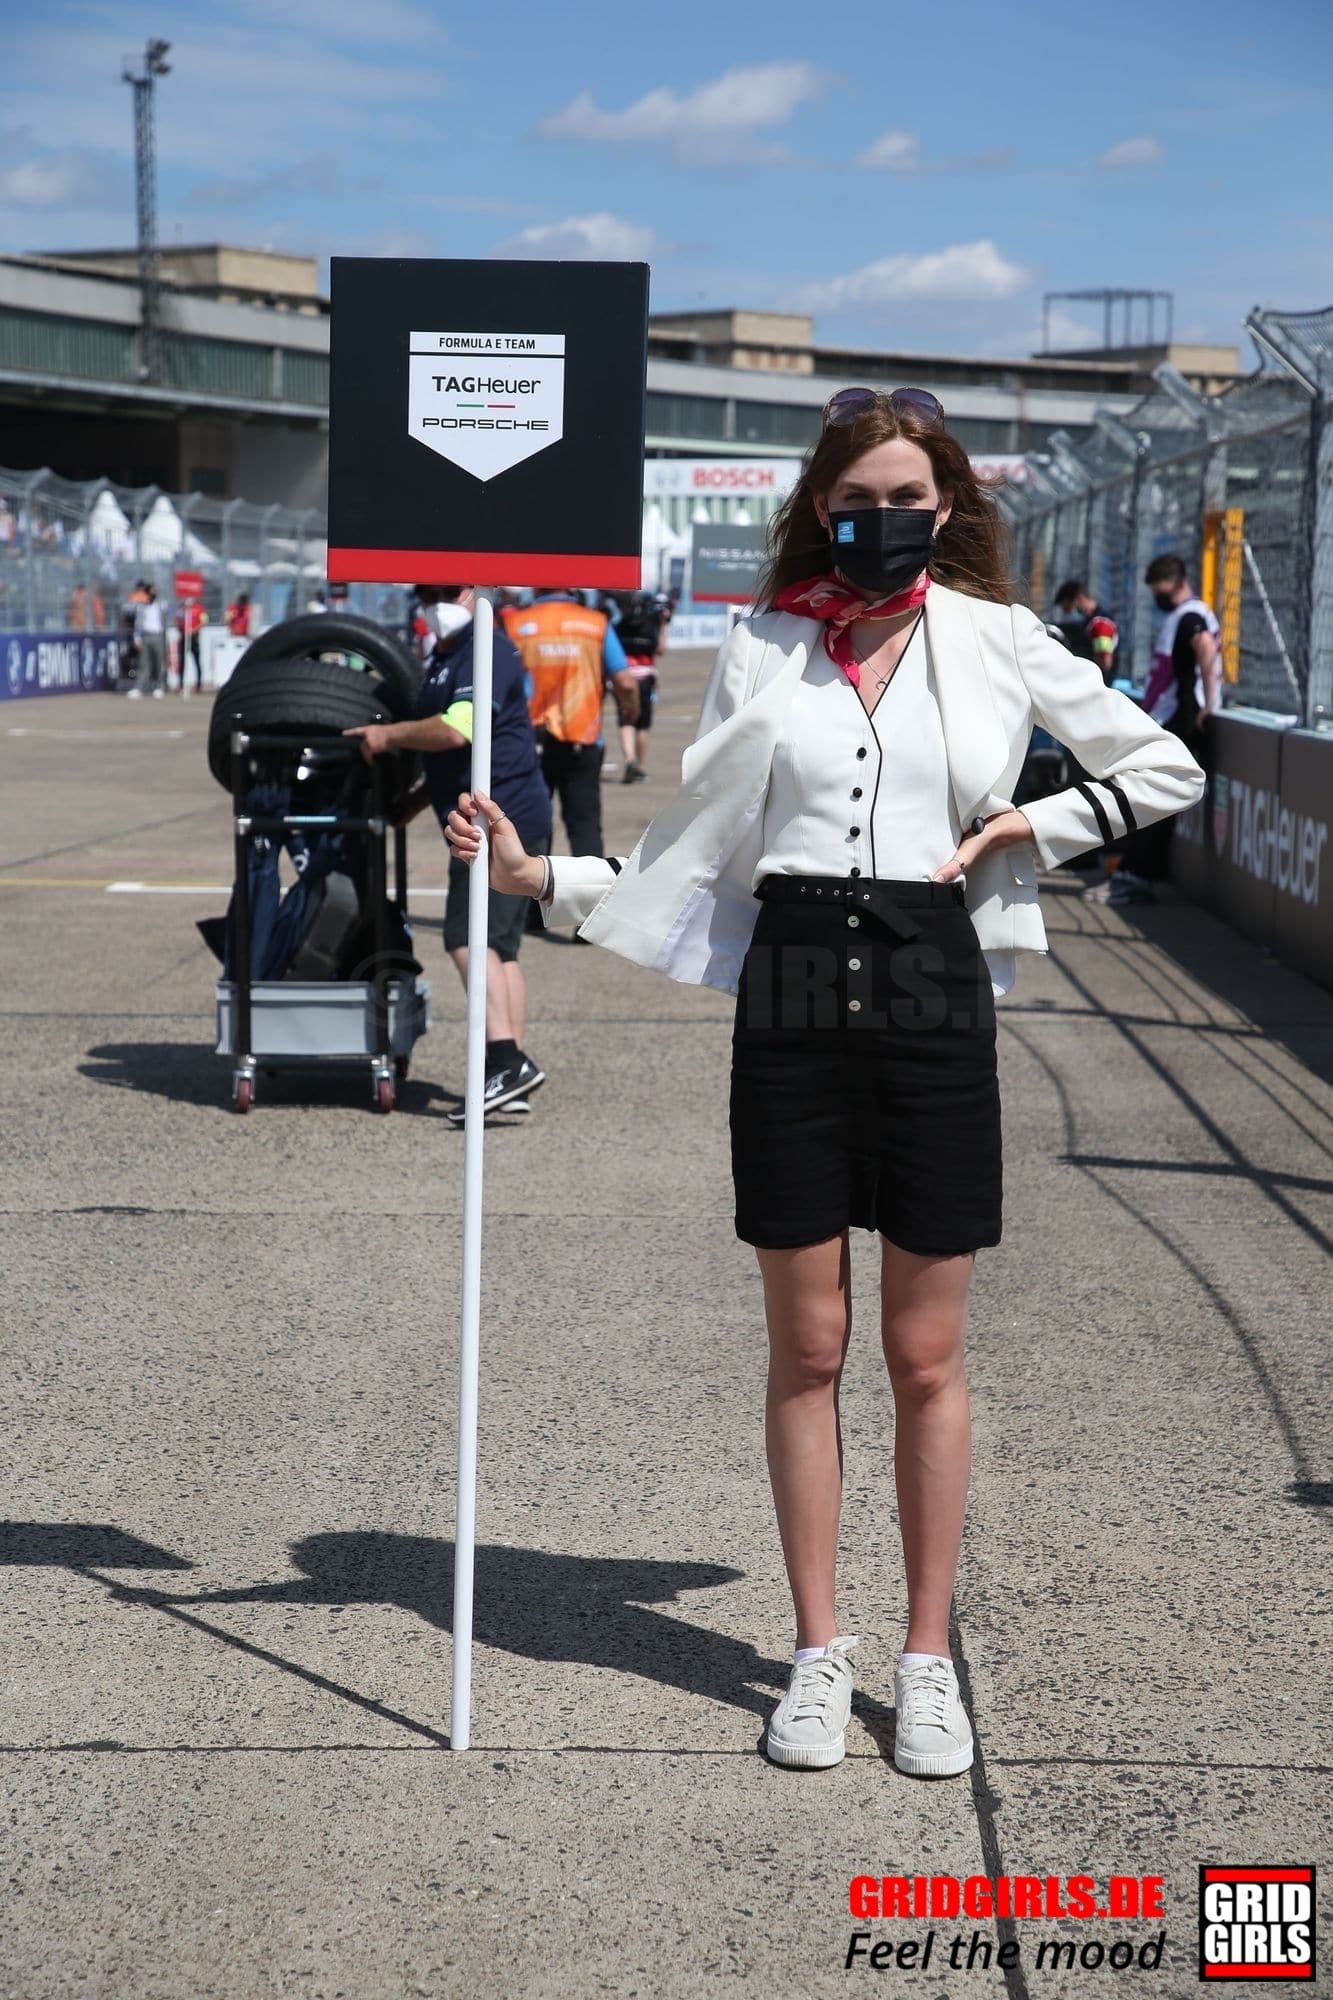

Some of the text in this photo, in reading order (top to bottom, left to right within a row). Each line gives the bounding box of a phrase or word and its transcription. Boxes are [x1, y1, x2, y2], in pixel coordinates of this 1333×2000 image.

[439, 337, 536, 350] FORMULA E TEAM
[422, 417, 550, 431] PORSCHE
[692, 467, 774, 487] BOSCH
